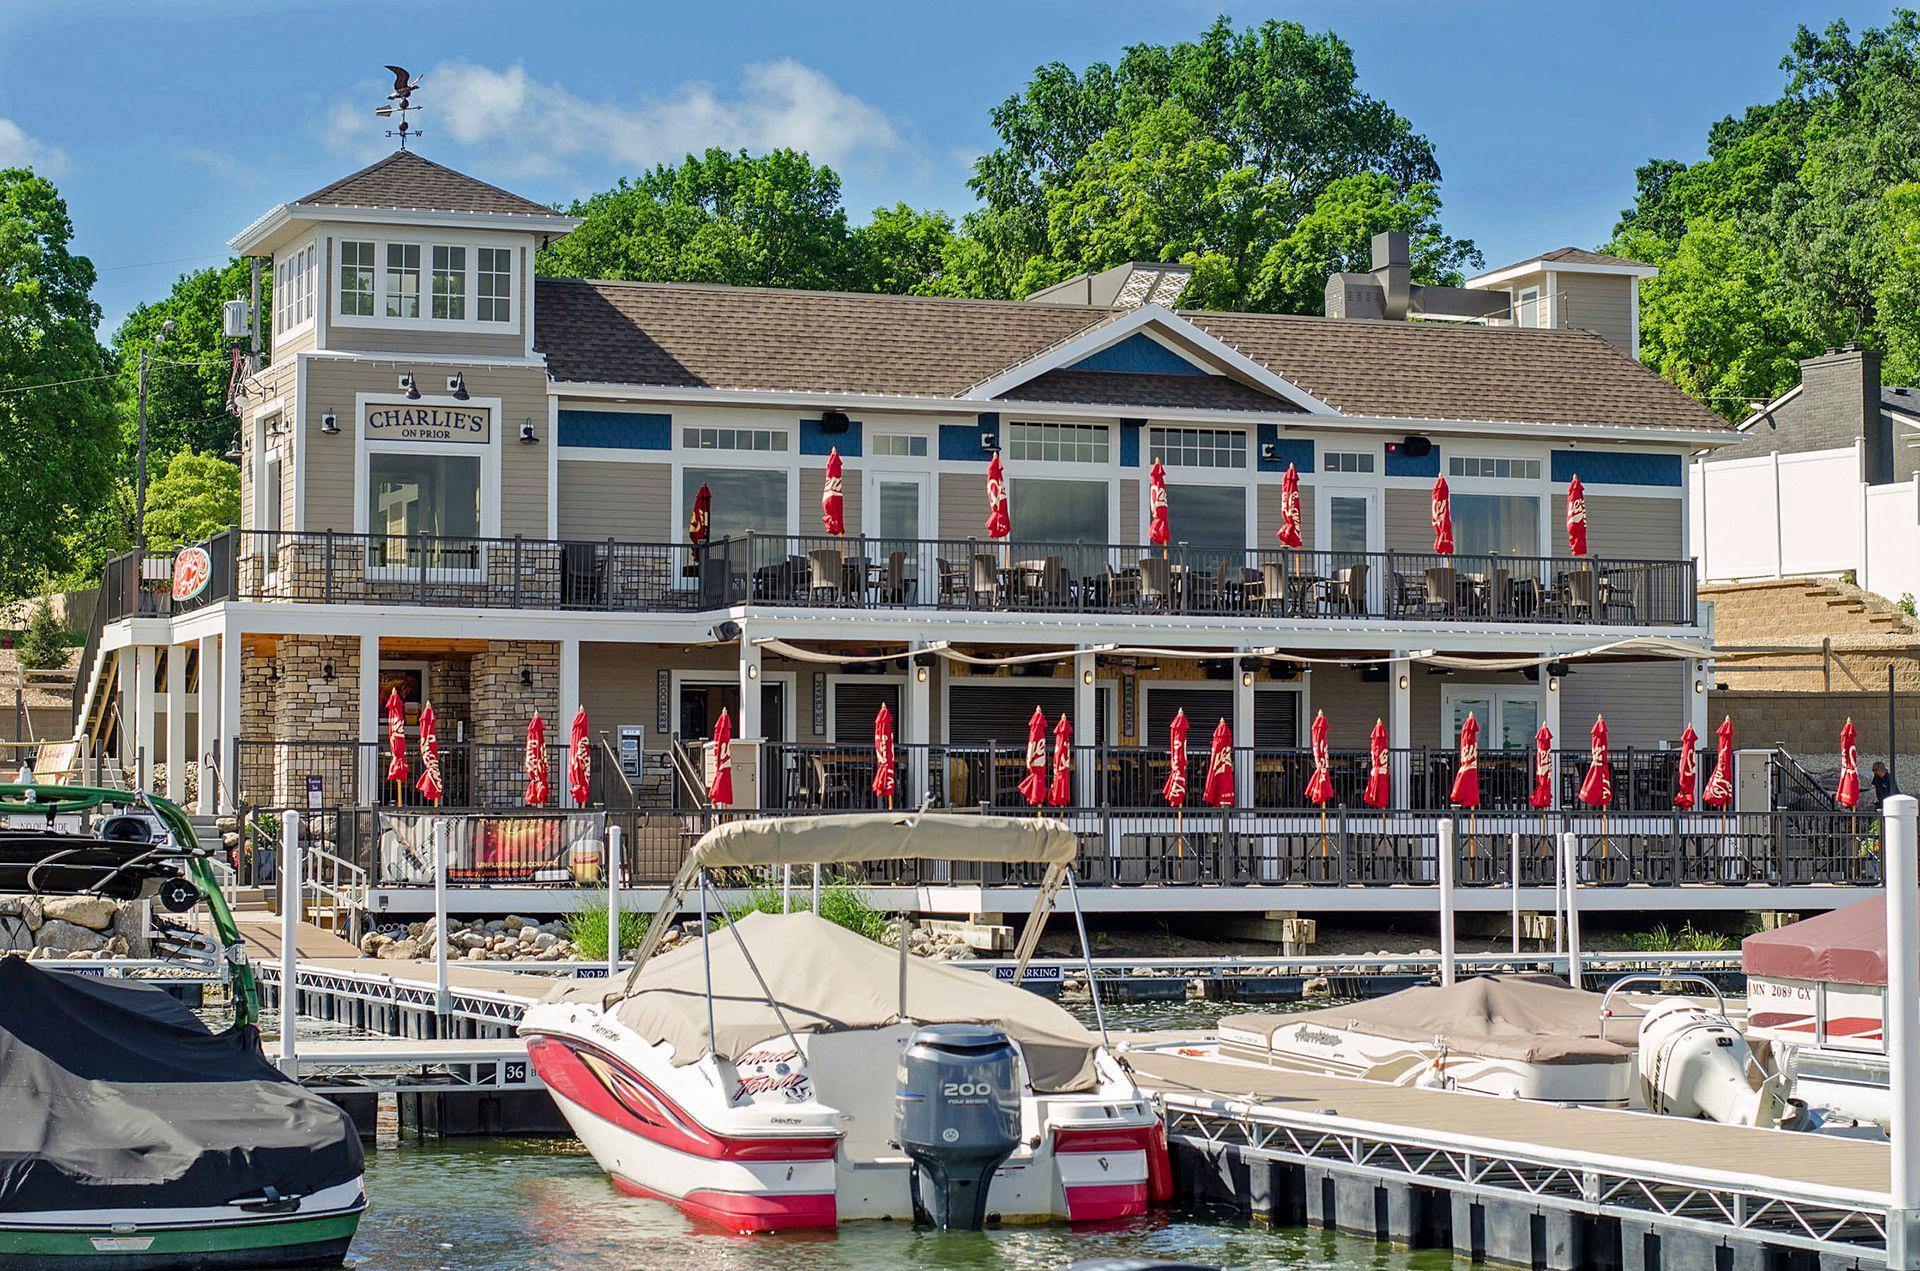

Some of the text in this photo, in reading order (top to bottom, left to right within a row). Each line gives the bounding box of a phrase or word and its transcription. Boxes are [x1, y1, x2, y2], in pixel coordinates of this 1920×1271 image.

[369, 409, 483, 432] CHARLIE'S
[402, 429, 451, 439] ON PRIOR
[815, 680, 823, 727] ICE CREAM
[580, 970, 595, 978] NO
[998, 968, 1013, 978] NO
[1753, 983, 1811, 1000] MN 2089 GX
[507, 1065, 524, 1079] 36
[944, 1083, 992, 1097] 200
